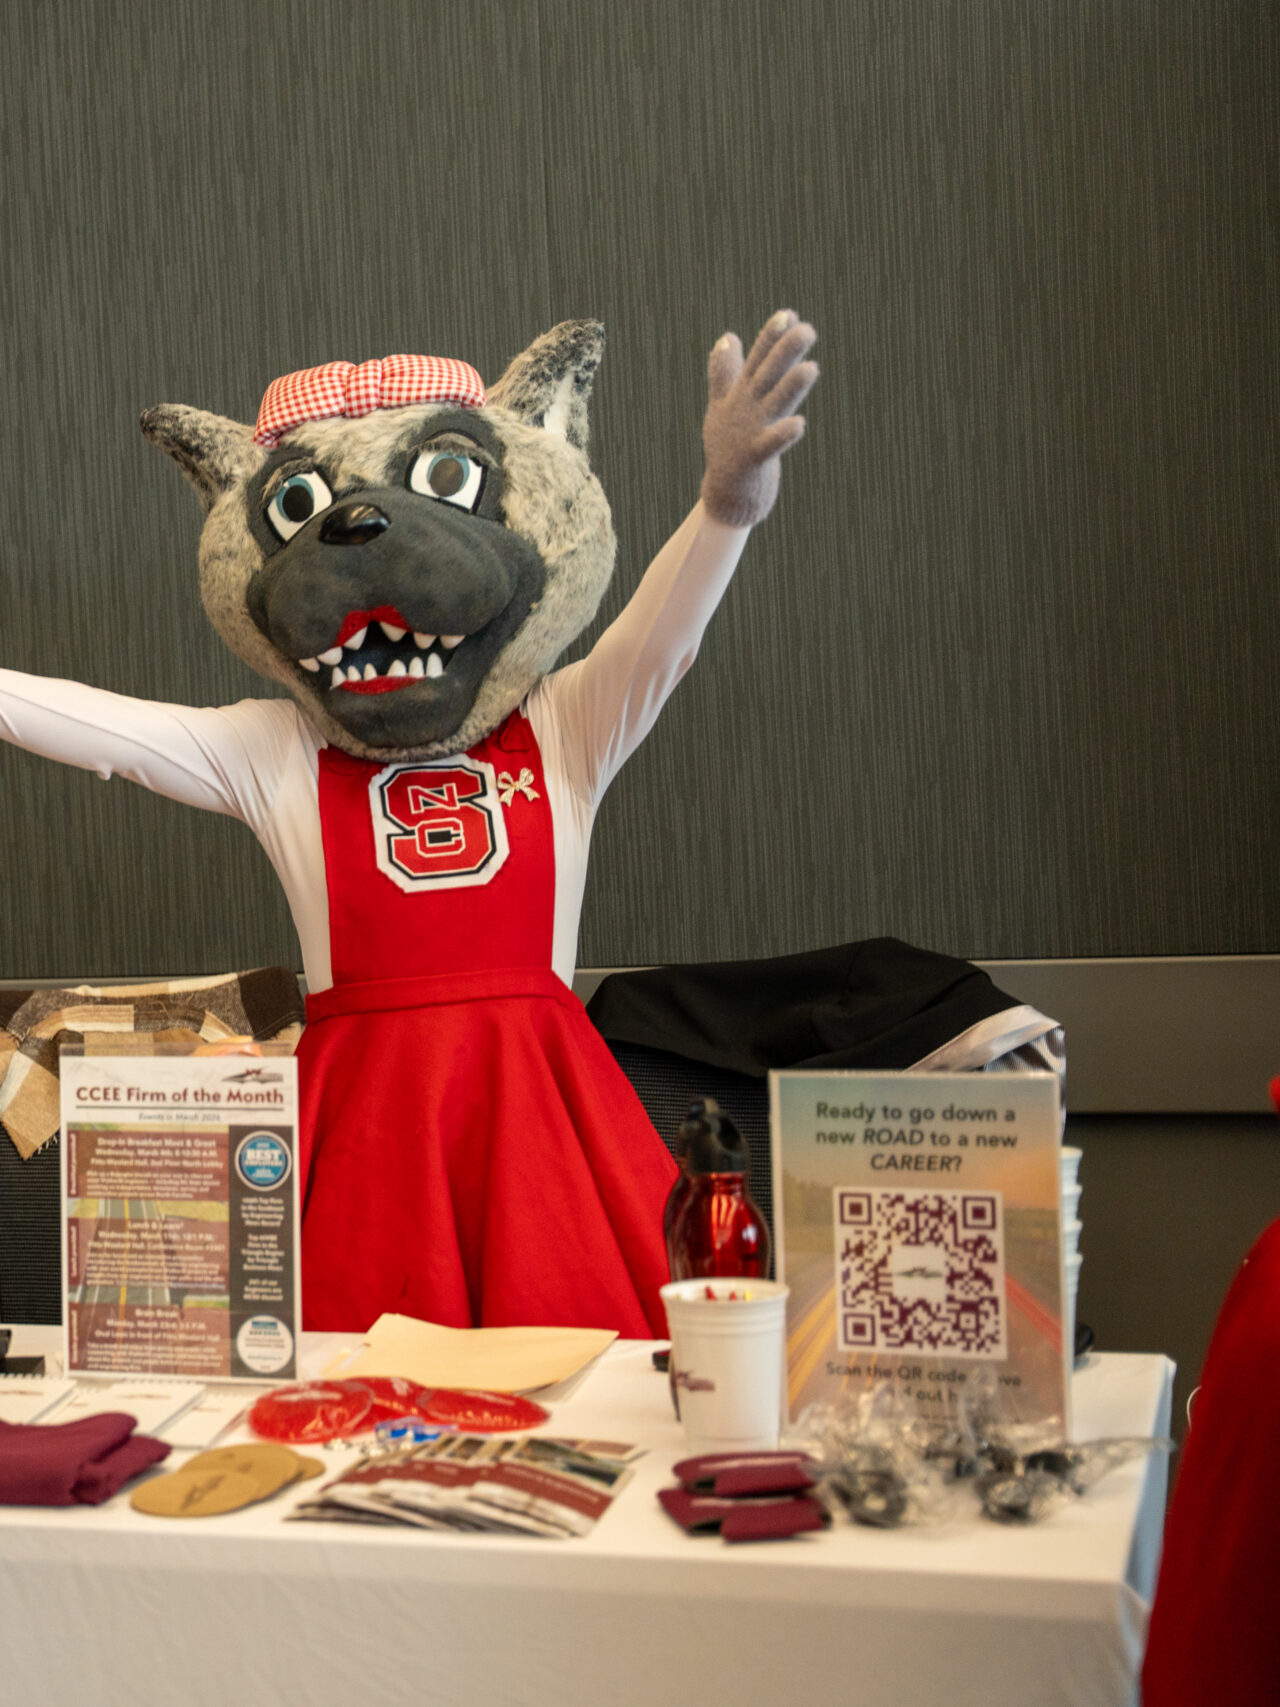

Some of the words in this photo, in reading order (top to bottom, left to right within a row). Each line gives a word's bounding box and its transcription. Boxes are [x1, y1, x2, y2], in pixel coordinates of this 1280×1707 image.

[76, 1087, 121, 1102] CCEE
[126, 1087, 167, 1102] Firm
[171, 1087, 190, 1103] of
[193, 1088, 222, 1104] the
[226, 1088, 285, 1105] Month
[816, 1102, 876, 1124] Ready
[882, 1105, 903, 1121] to
[909, 1109, 936, 1126] go
[942, 1103, 998, 1122] down
[1004, 1108, 1017, 1123] a
[815, 1131, 856, 1146] new
[863, 1128, 925, 1147] ROAD
[930, 1130, 951, 1148] to
[958, 1134, 969, 1148] a
[975, 1134, 1018, 1149] new
[870, 1153, 964, 1173] CAREER?
[825, 1362, 863, 1379] Scan
[866, 1363, 895, 1380] the
[897, 1364, 923, 1383] QR
[928, 1368, 968, 1384] code
